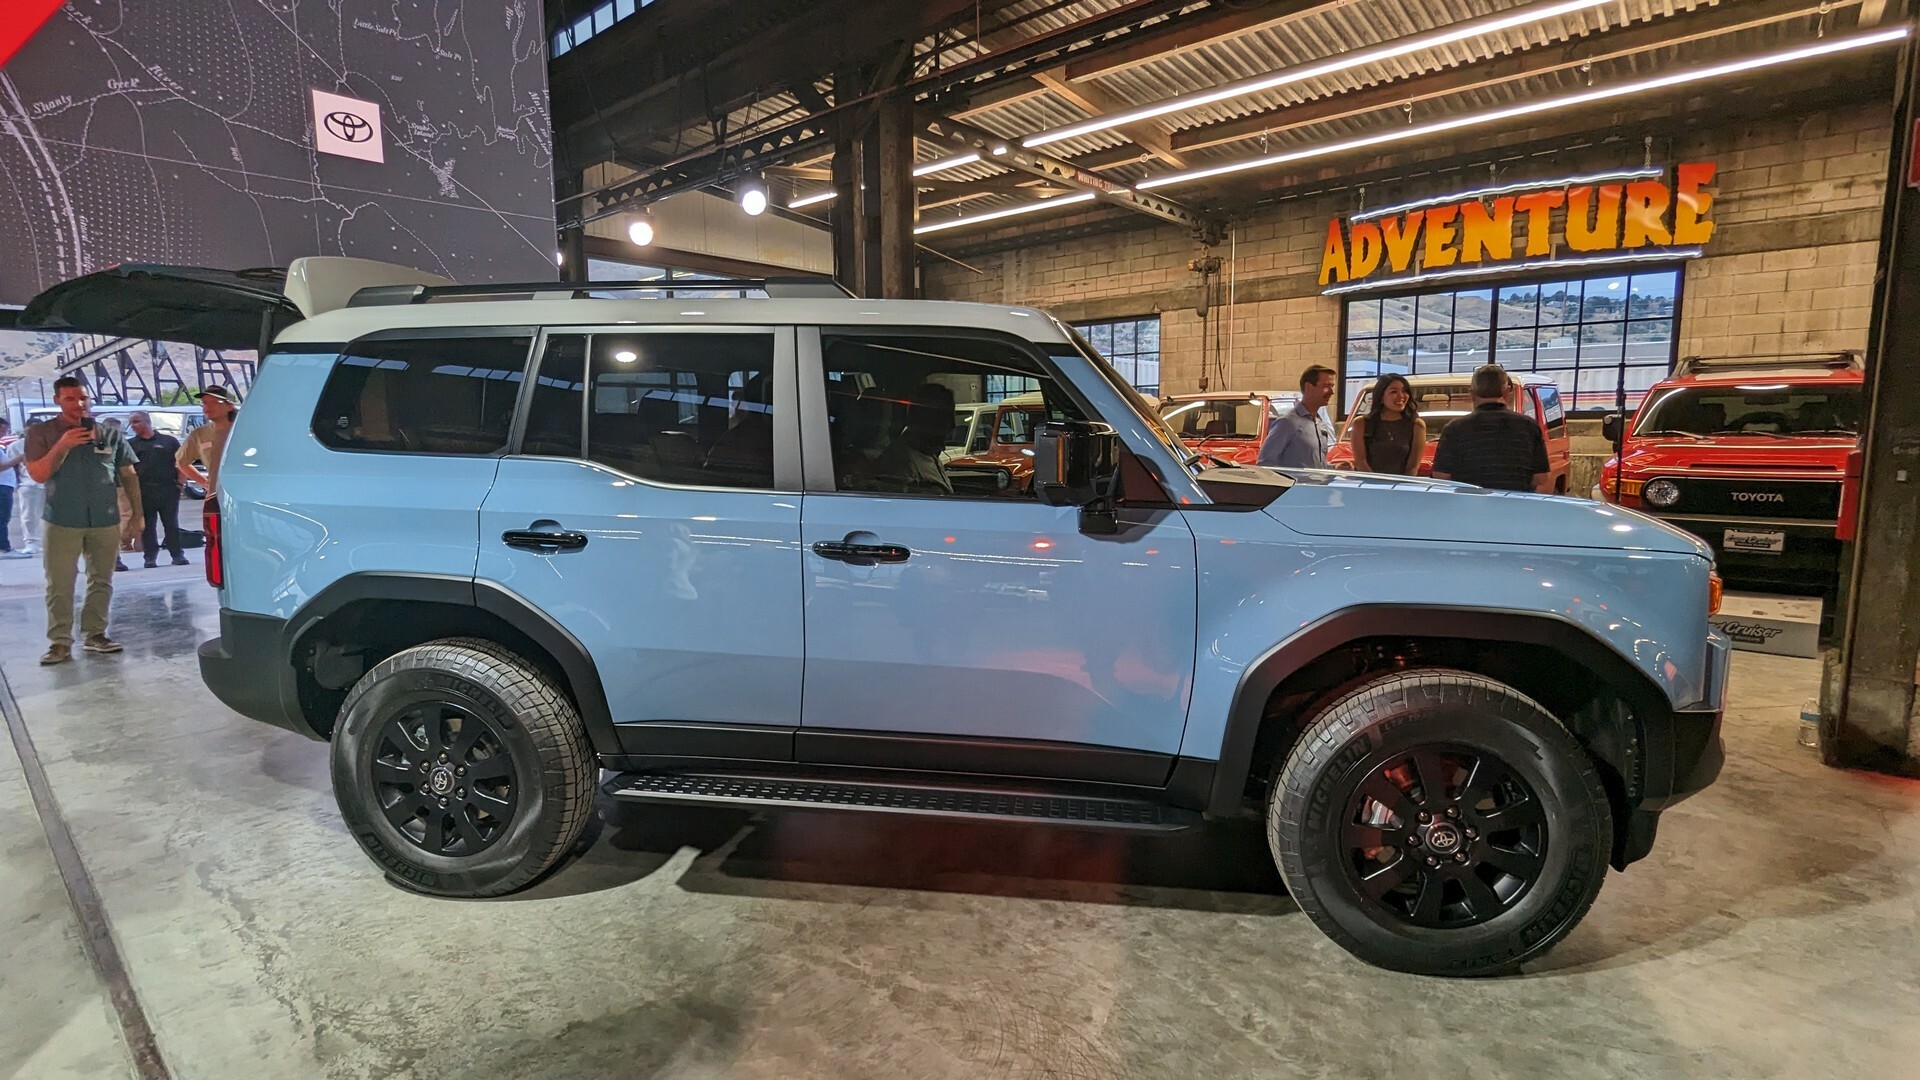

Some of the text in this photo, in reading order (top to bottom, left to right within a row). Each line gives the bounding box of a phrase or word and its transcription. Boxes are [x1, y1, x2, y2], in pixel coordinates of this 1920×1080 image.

[149, 63, 184, 91] River
[33, 94, 72, 115] Shanty
[1318, 162, 1717, 286] ADVENTURE
[1730, 492, 1785, 502] TOYOTA
[1723, 621, 1783, 638] Cruiser
[1308, 737, 1370, 829] MICHELIN
